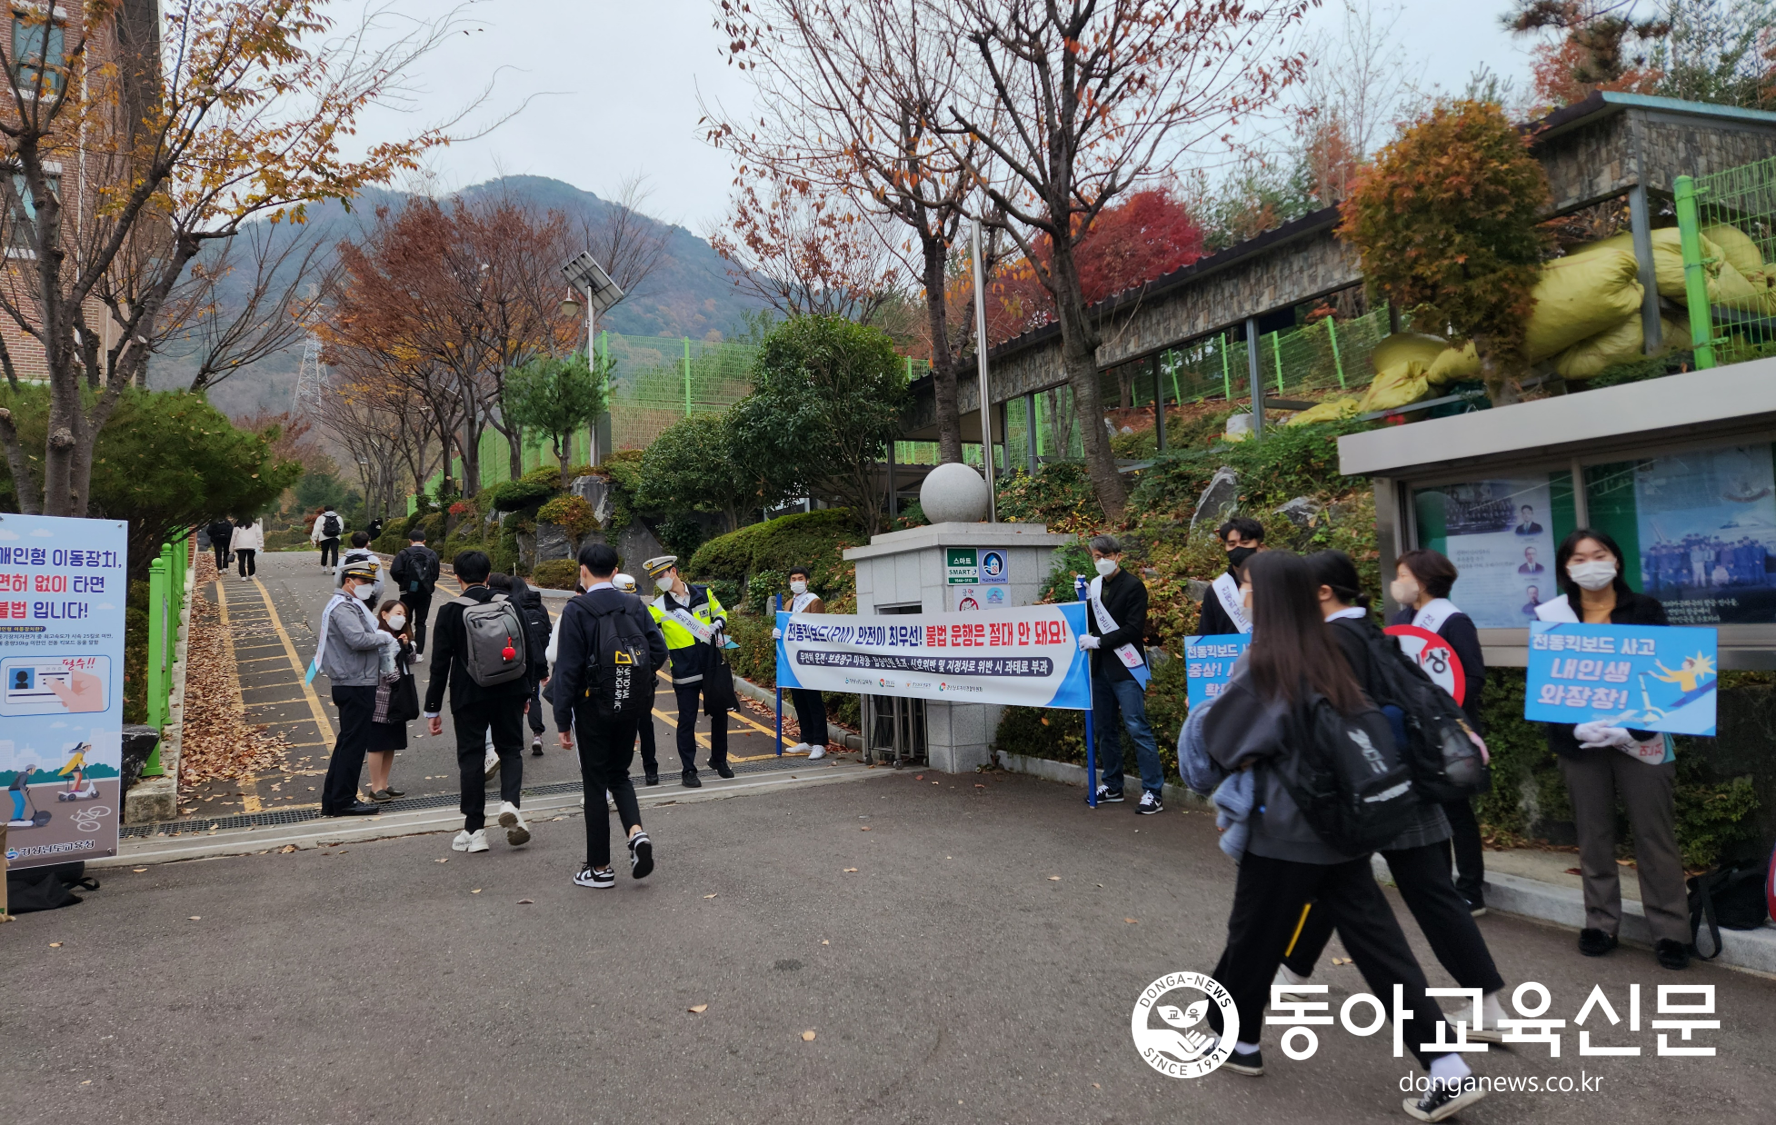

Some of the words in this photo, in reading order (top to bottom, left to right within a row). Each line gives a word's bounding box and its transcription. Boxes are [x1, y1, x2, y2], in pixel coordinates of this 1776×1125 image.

[52, 549, 122, 568] 이동장치,
[34, 574, 67, 593] 없이
[73, 575, 105, 593] 타면
[33, 601, 88, 619] 입니다!
[787, 623, 854, 643] 전동킥보드(PM)
[855, 626, 886, 646] 안전이
[888, 625, 923, 647] 최우선!
[926, 625, 947, 647] 불법
[951, 623, 986, 647] 운행은
[989, 622, 1013, 646] 절대
[1018, 621, 1030, 646] 안
[1034, 620, 1066, 645] 돼요!
[1187, 644, 1239, 659] 전동킥보드
[1533, 633, 1616, 654] 전동킥보드
[1620, 638, 1656, 656] 사고
[62, 657, 96, 671] 필수!!
[938, 660, 946, 672] 및
[946, 660, 976, 673] 지정차로
[978, 660, 993, 674] 위반
[995, 660, 1003, 674] 시
[1004, 660, 1029, 674] 과태료
[1031, 660, 1049, 674] 부과
[1188, 662, 1222, 678] 중상!
[1550, 658, 1632, 683] 내인생
[1537, 684, 1629, 710] 와장창!
